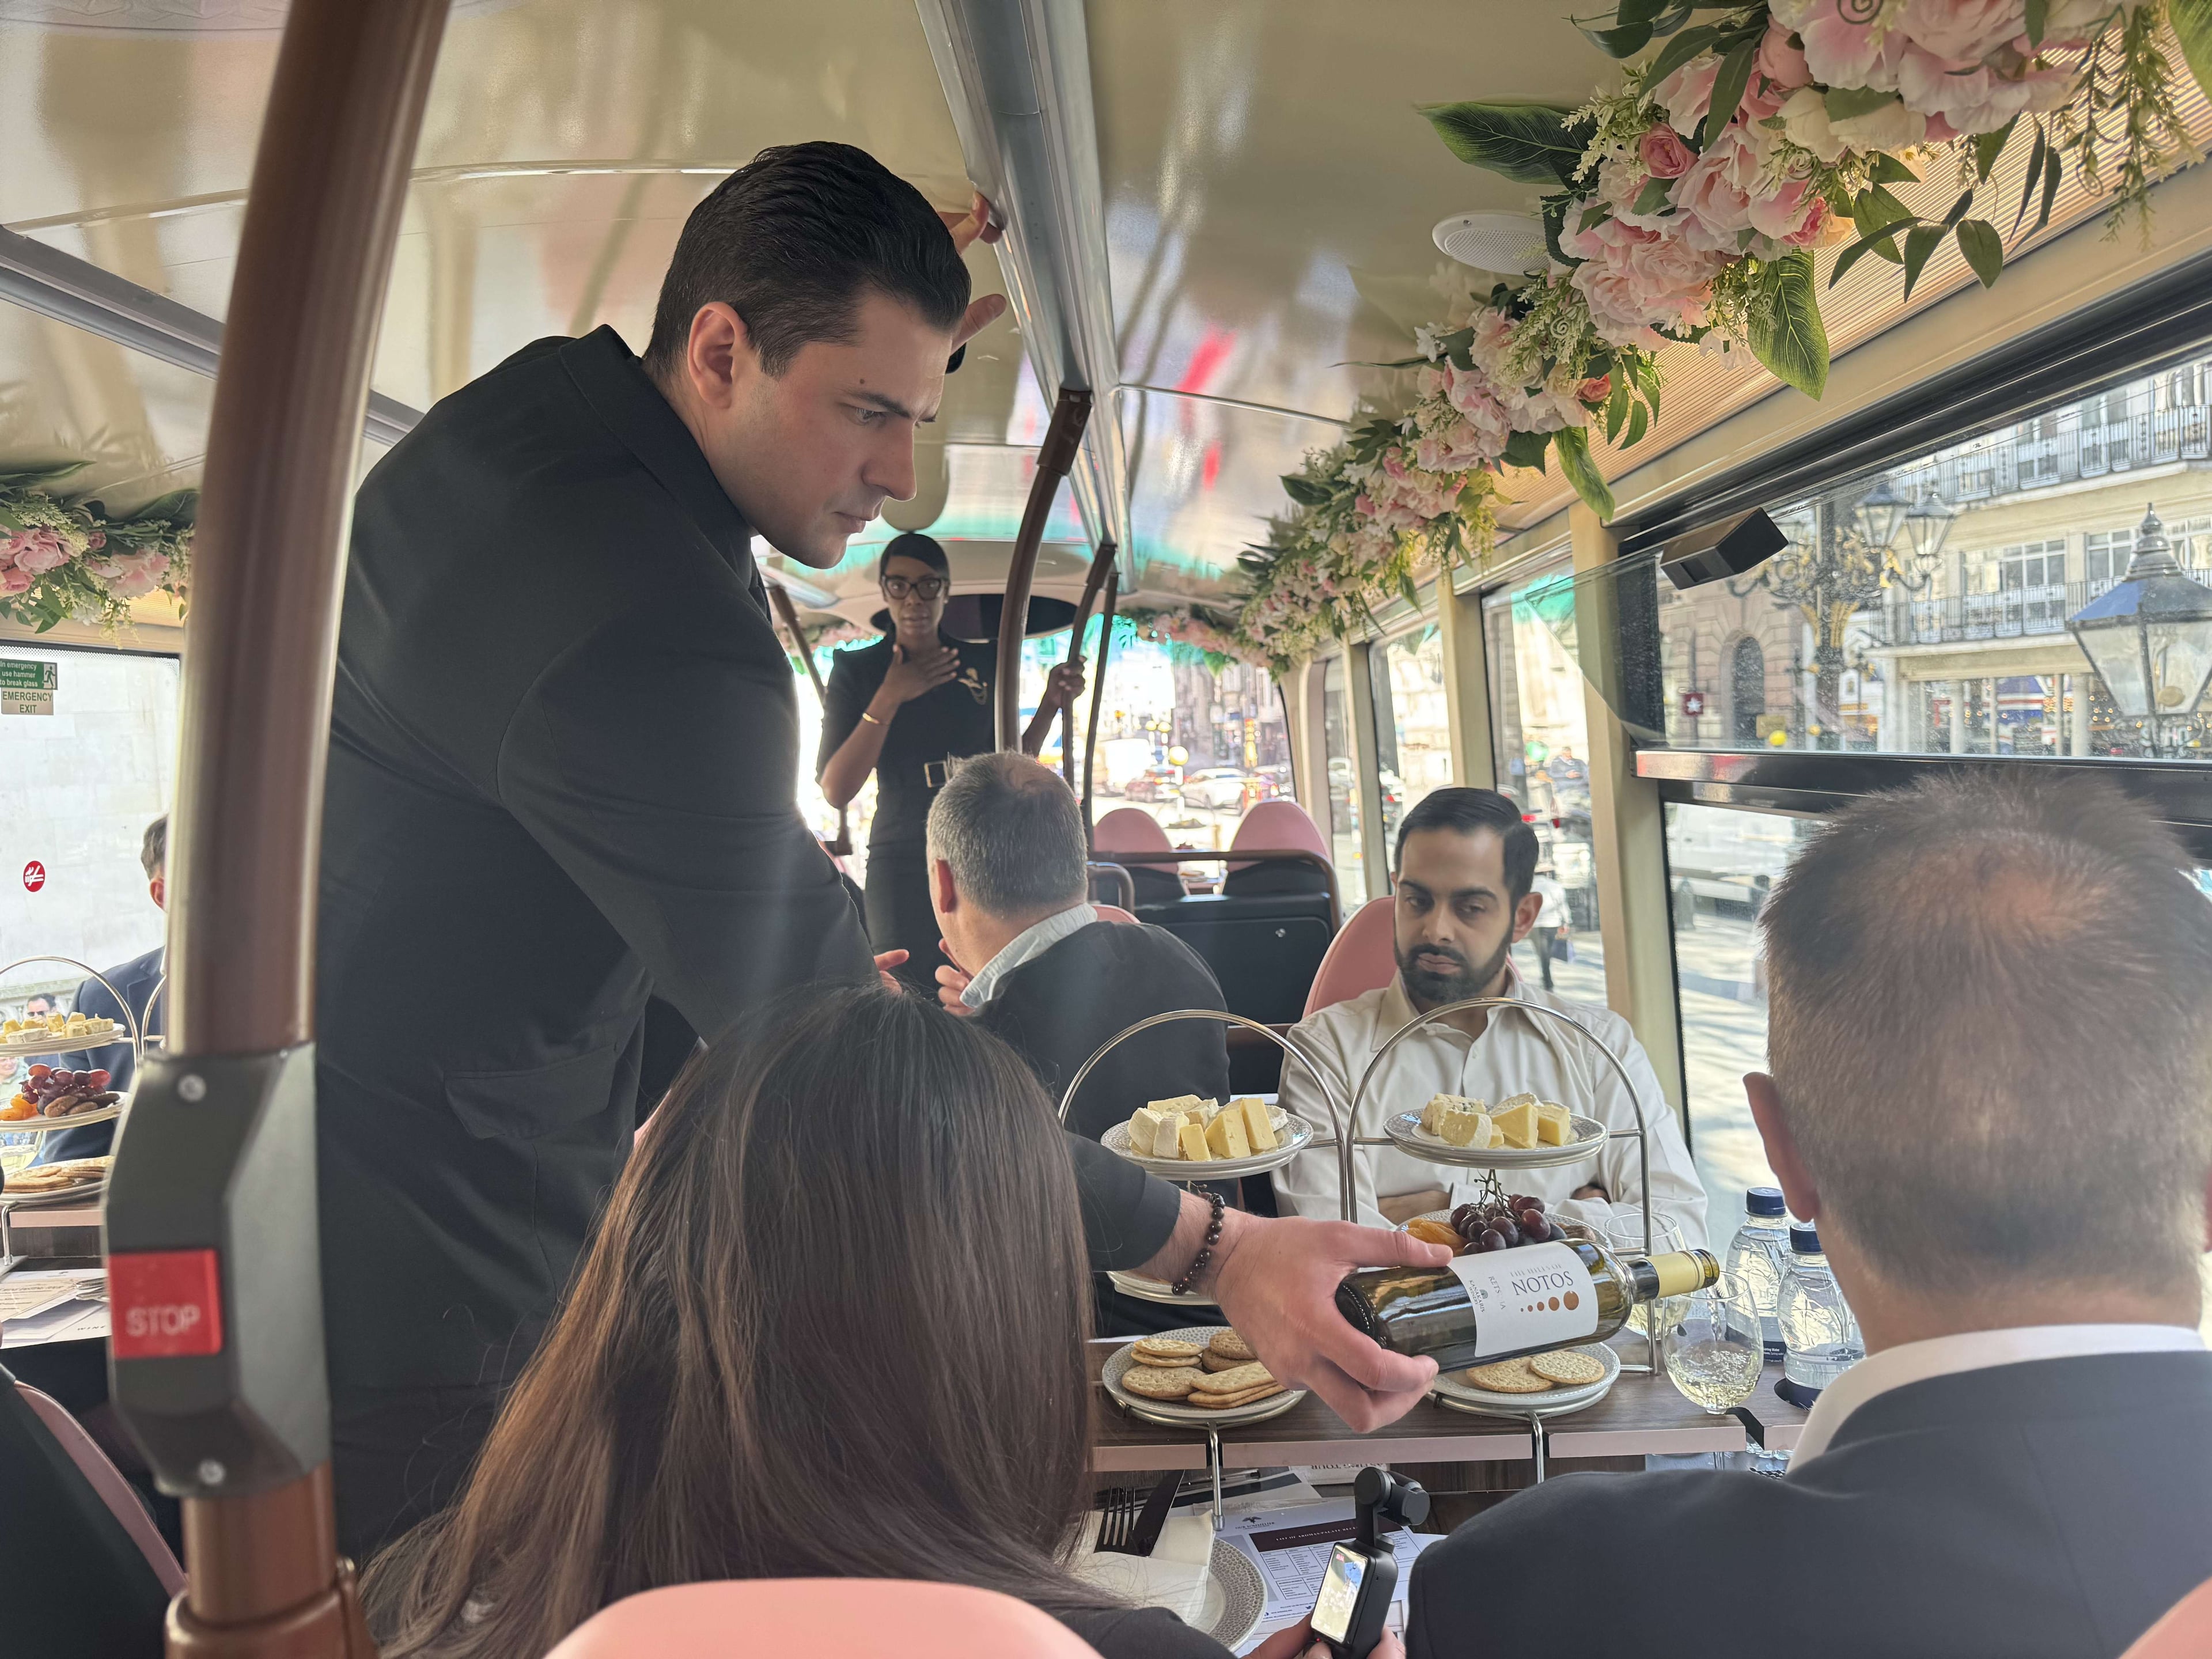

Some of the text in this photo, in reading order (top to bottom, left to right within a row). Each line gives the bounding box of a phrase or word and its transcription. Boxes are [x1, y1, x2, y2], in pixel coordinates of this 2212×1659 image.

[7, 662, 37, 671] emergency
[2, 691, 52, 702] EMERGENCY
[20, 704, 37, 713] EXIT
[1511, 1271, 1573, 1296] NOTOS
[126, 1304, 201, 1336] STOP
